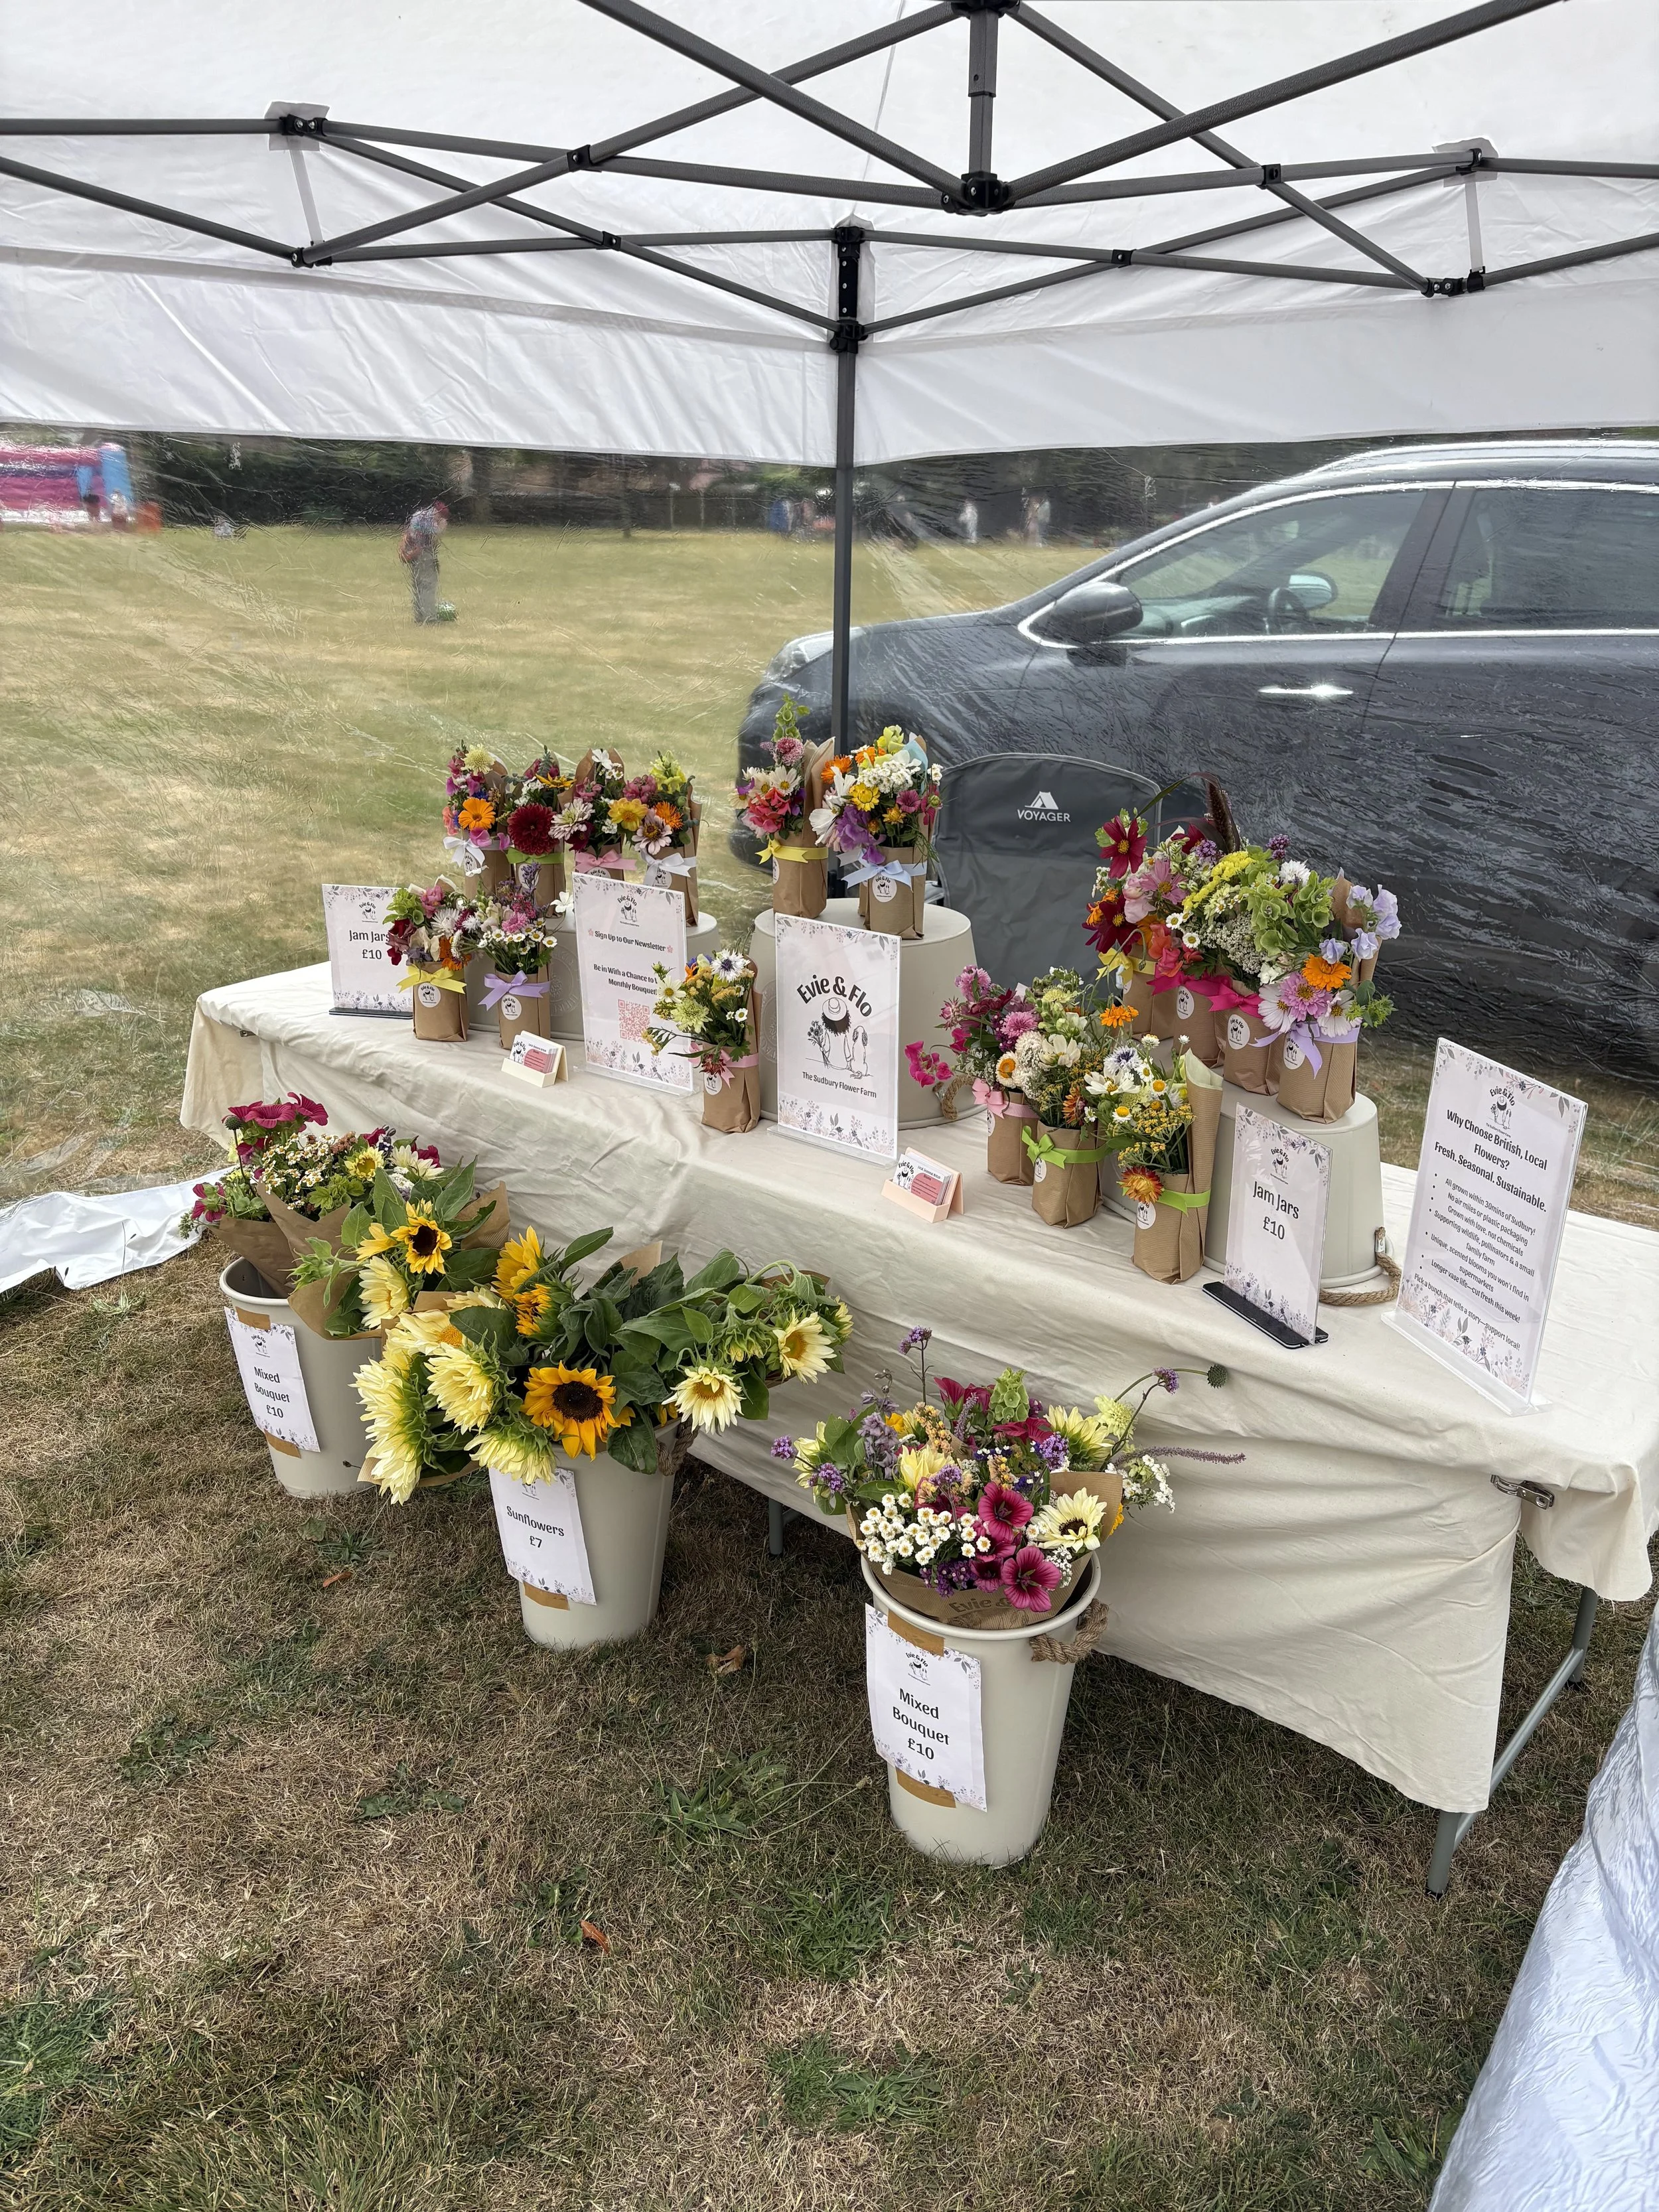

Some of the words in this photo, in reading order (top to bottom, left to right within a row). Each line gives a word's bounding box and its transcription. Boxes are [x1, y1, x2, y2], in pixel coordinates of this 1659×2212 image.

[1017, 809, 1070, 822] VOYAGER
[350, 930, 369, 941] Jam
[372, 931, 390, 943] Jars
[595, 930, 607, 940] Sign
[608, 933, 616, 942] Up
[623, 936, 634, 945] Our
[634, 939, 666, 952] Newsletter
[362, 949, 382, 960] £10
[601, 964, 607, 973] in
[608, 966, 621, 976] With
[626, 972, 647, 982] Chance
[608, 978, 631, 990] Monthly
[632, 985, 657, 995] Bouquet!
[796, 974, 830, 1003] Evie
[833, 976, 847, 997] &
[848, 984, 872, 1017] Flo
[802, 1072, 812, 1080] The
[814, 1074, 838, 1088] Sudbury
[839, 1082, 860, 1094] Flower
[861, 1088, 877, 1098] Farm
[1490, 1086, 1502, 1096] Evie
[1502, 1088, 1507, 1097] &
[1447, 1110, 1464, 1128] Why
[1464, 1119, 1492, 1142] Choose
[1494, 1134, 1523, 1159] British,
[1525, 1149, 1548, 1170] Local
[1474, 1143, 1510, 1170] Flowers?
[1435, 1142, 1457, 1162] Fresh.
[1458, 1155, 1494, 1183] Seasonal.
[1496, 1175, 1546, 1213] Sustainable.
[1253, 1181, 1274, 1205] Jam
[1275, 1194, 1299, 1219] Jars
[1452, 1183, 1468, 1196] grown
[1469, 1193, 1484, 1206] within
[1484, 1201, 1504, 1217] 30mins
[1511, 1216, 1536, 1235] Sudbury!
[1263, 1217, 1285, 1240] £10
[1447, 1193, 1454, 1201] No
[1463, 1200, 1476, 1213] miles
[1483, 1215, 1500, 1228] plastic
[1500, 1224, 1528, 1246] packaging
[1448, 1206, 1463, 1220] Grown
[1464, 1215, 1475, 1226] with
[1475, 1222, 1486, 1235] love,
[1488, 1230, 1496, 1239] not
[1496, 1234, 1524, 1256] chemicals
[1434, 1211, 1461, 1233] Supporting
[1461, 1228, 1480, 1244] wildlife,
[1481, 1240, 1509, 1262] pollinators
[1519, 1263, 1534, 1278] small
[1466, 1242, 1482, 1258] family
[1482, 1253, 1495, 1266] farm
[1431, 1234, 1449, 1251] Unique,
[1449, 1246, 1468, 1262] scented
[1469, 1257, 1487, 1274] blooms
[1488, 1270, 1497, 1281] you
[1497, 1276, 1512, 1291] won't
[1512, 1285, 1523, 1297] find
[1524, 1292, 1529, 1302] in
[1459, 1266, 1494, 1292] supermarkets
[1431, 1260, 1448, 1275] Longer
[1448, 1272, 1459, 1282] vase
[1480, 1291, 1494, 1305] fresh
[1494, 1299, 1504, 1312] this
[1505, 1308, 1520, 1323] week!
[1414, 1273, 1424, 1284] Pick
[1428, 1282, 1443, 1297] bunch
[1443, 1292, 1453, 1305] that
[1453, 1300, 1464, 1312] tells
[1506, 1335, 1520, 1351] local!
[254, 1366, 280, 1383] Mixed
[254, 1382, 290, 1402] Bouquet
[267, 1405, 283, 1418] £10
[506, 1506, 564, 1536] Sunflowers
[530, 1536, 542, 1548] £7
[950, 1598, 992, 1613] Evie
[900, 1688, 939, 1720] Mixed
[893, 1706, 950, 1745] Bouquet
[908, 1737, 934, 1760] £10
